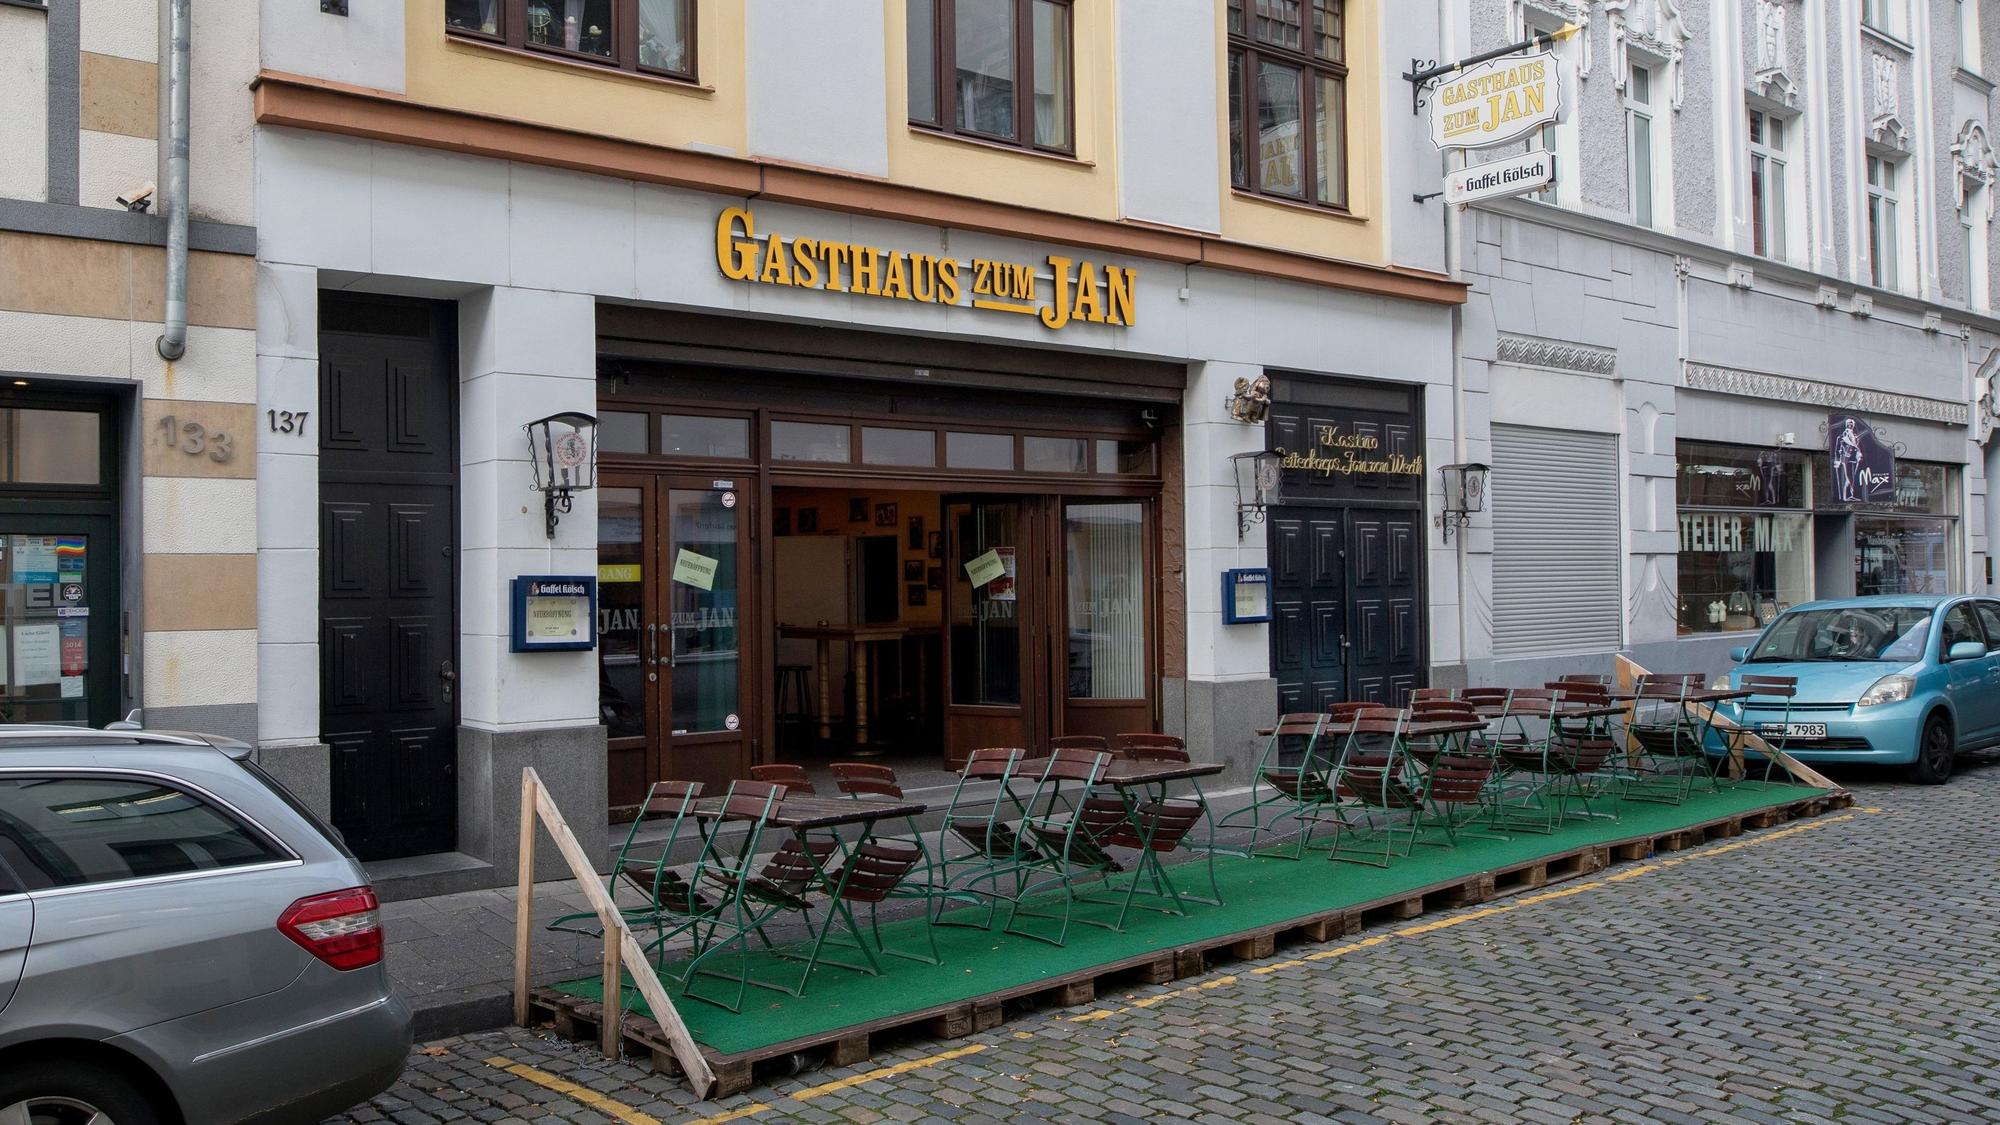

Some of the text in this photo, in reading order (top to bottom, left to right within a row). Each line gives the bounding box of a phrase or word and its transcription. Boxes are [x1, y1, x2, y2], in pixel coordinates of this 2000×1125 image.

[1442, 60, 1545, 106] GASTHAUS
[1443, 82, 1545, 132] ZUM JAN
[1466, 162, 1544, 191] Gaffel Kölsch
[715, 206, 1137, 329] GASTHAUS ZUM JAN
[267, 409, 309, 436] 137
[159, 415, 232, 463] 133
[1320, 425, 1379, 450] Kasino
[1859, 466, 1890, 493] Max
[1754, 515, 1793, 552] MAX
[541, 584, 585, 594] Gaffel Kölsch
[599, 609, 639, 635] JAN
[696, 607, 734, 632] JAN
[980, 600, 1013, 621] JAN
[1794, 725, 1824, 735] 7983
